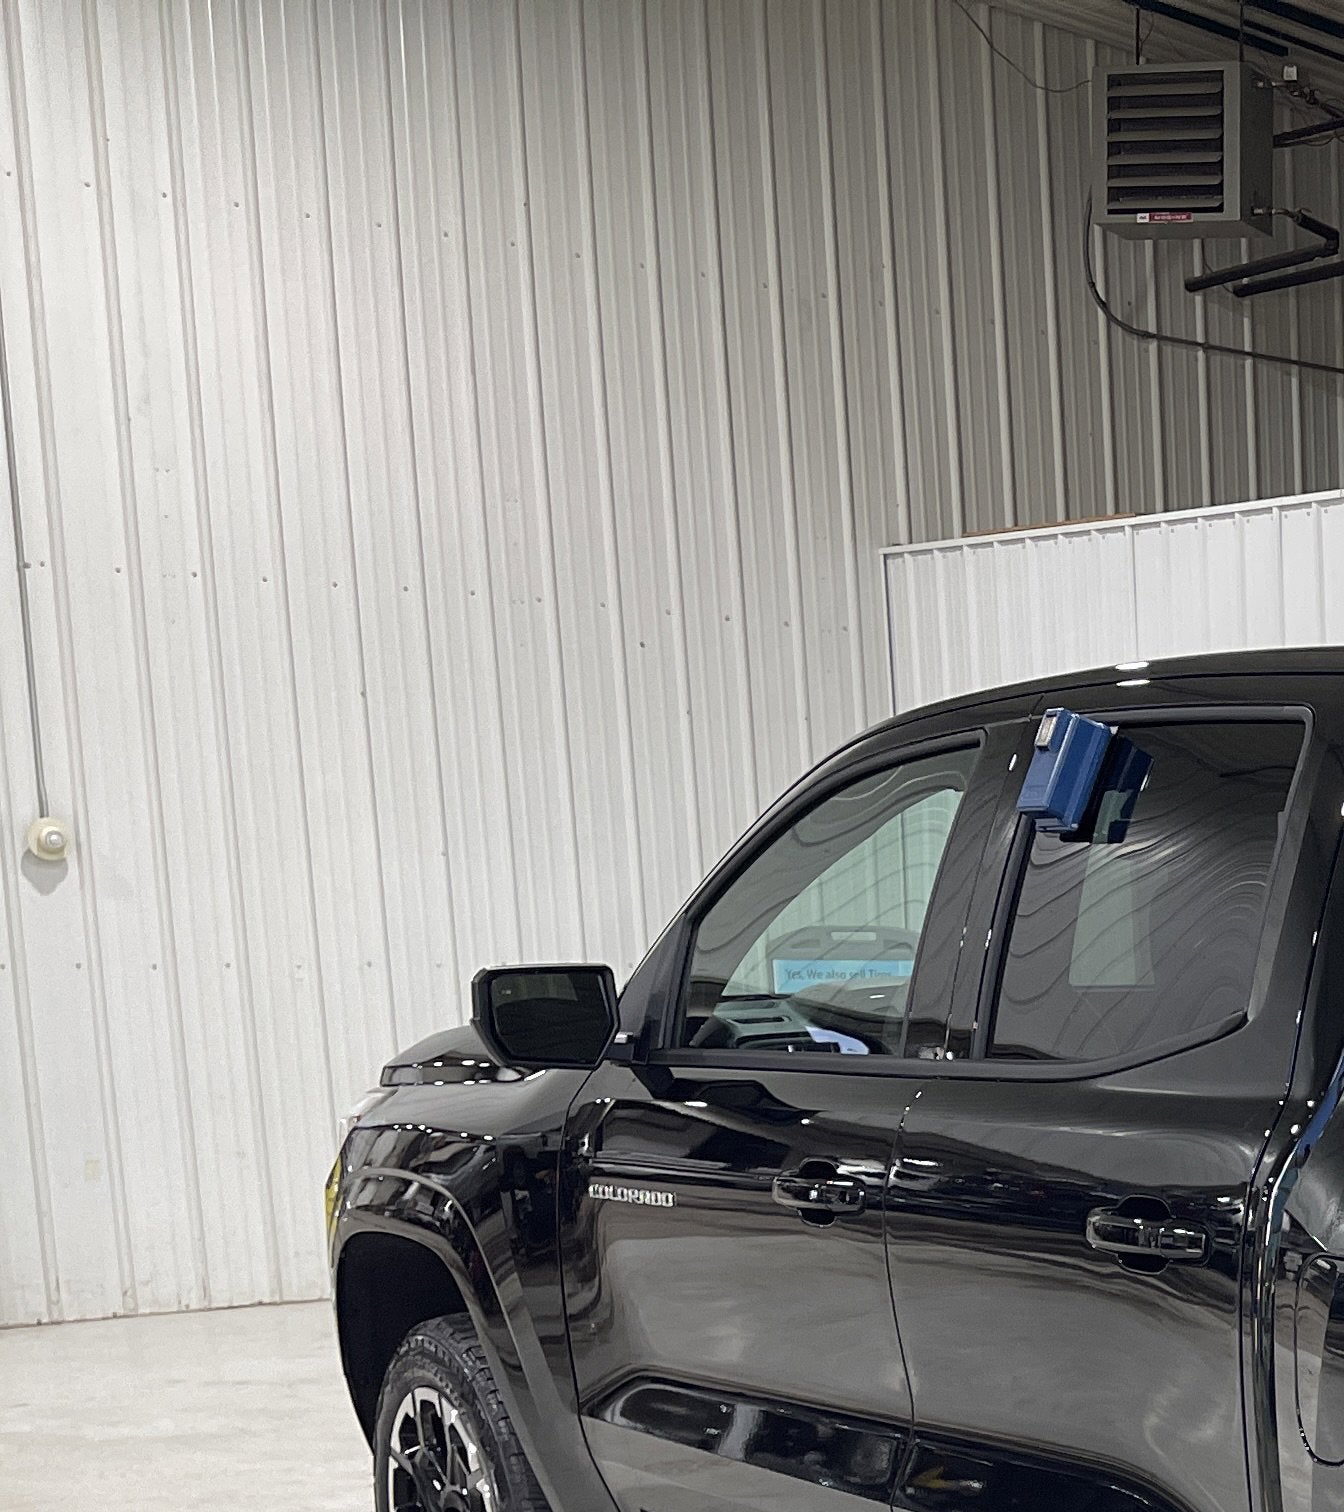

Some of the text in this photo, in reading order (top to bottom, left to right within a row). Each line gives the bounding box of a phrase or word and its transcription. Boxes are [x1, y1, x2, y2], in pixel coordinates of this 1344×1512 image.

[806, 970, 823, 980] We
[825, 969, 847, 980] also
[588, 1184, 674, 1207] COLORADO
